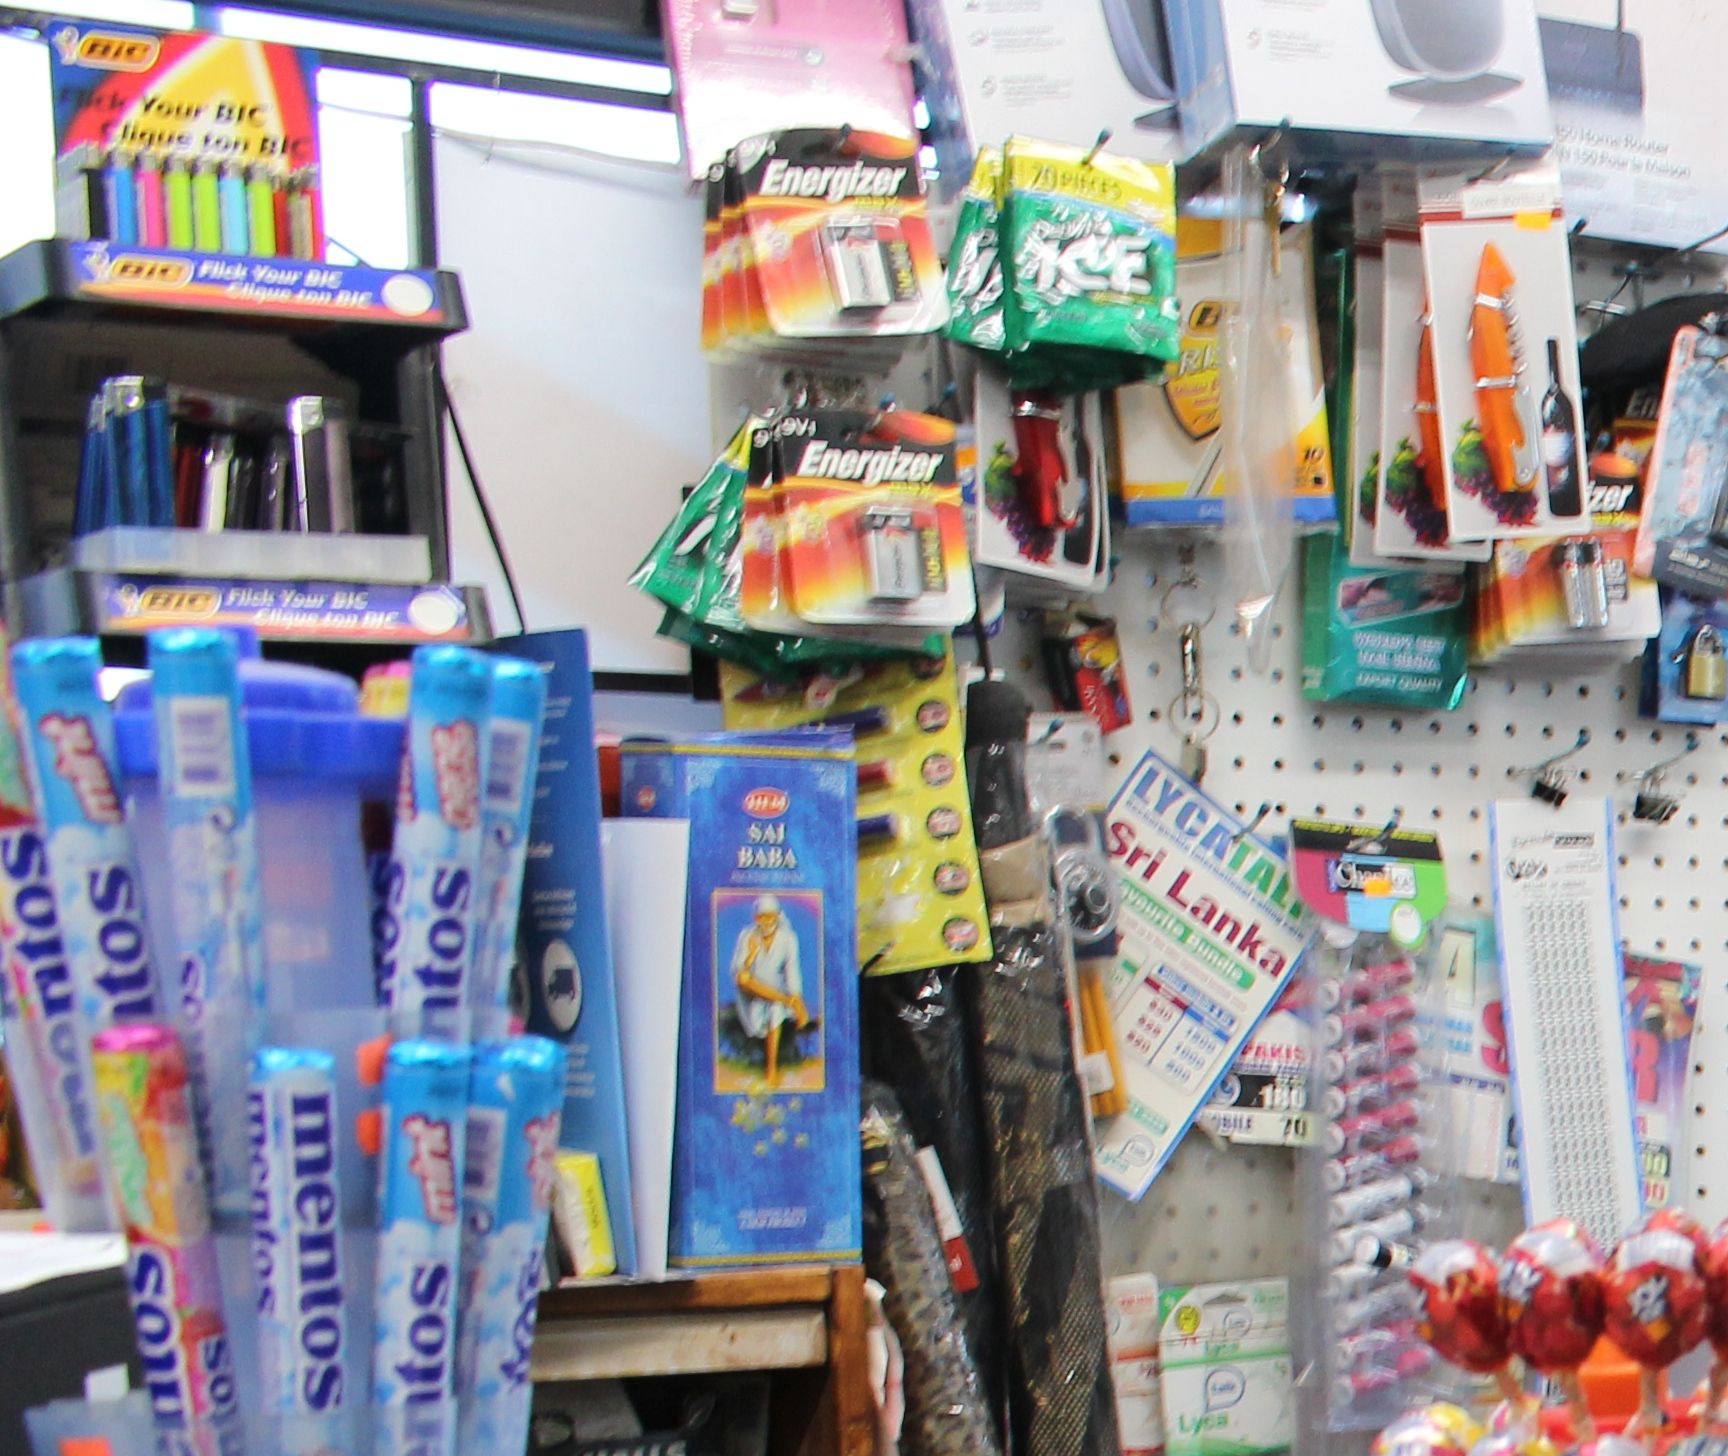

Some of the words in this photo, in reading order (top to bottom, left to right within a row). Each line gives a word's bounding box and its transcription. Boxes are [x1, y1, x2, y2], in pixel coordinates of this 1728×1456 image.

[143, 97, 203, 117] Your
[216, 102, 268, 127] BIC
[204, 134, 249, 152] ton
[260, 136, 308, 157] BIC
[760, 159, 907, 199] Energizer
[201, 260, 248, 280] Flick
[252, 264, 302, 285] Your
[304, 269, 343, 289] BIC
[227, 282, 295, 304] Clique
[298, 287, 333, 303] ton
[335, 290, 372, 308] BIC
[799, 441, 944, 484] Energizer
[225, 588, 274, 607] Flick
[281, 589, 327, 608] Your
[331, 591, 369, 610] BIC
[254, 607, 320, 628] Clique
[322, 611, 358, 626] ton
[361, 611, 400, 629] BIC
[749, 822, 785, 844] SAI
[738, 847, 796, 869] BABA
[1110, 822, 1170, 880] Sri
[1166, 868, 1287, 980] Lanka
[292, 1093, 342, 1411] mentos
